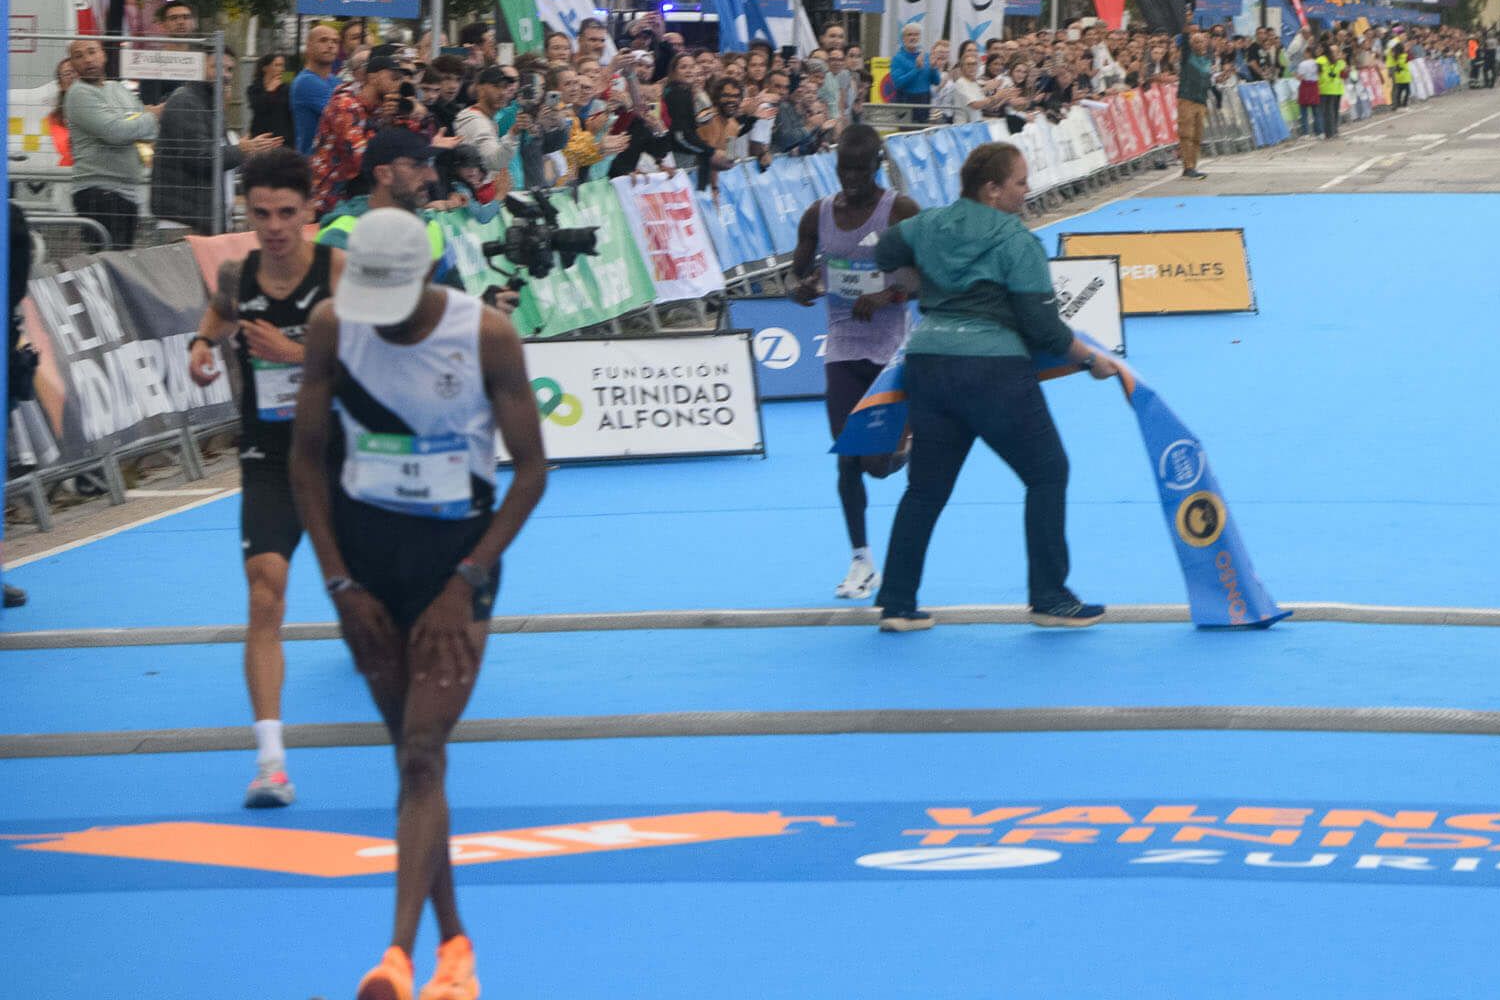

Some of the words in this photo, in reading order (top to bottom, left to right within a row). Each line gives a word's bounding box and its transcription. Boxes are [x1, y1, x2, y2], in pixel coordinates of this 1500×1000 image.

[1120, 262, 1226, 280] PERHALFS
[591, 362, 730, 380] FUNDACIÓN
[592, 382, 732, 407] TRINIDAD
[597, 406, 736, 431] ALFONSO
